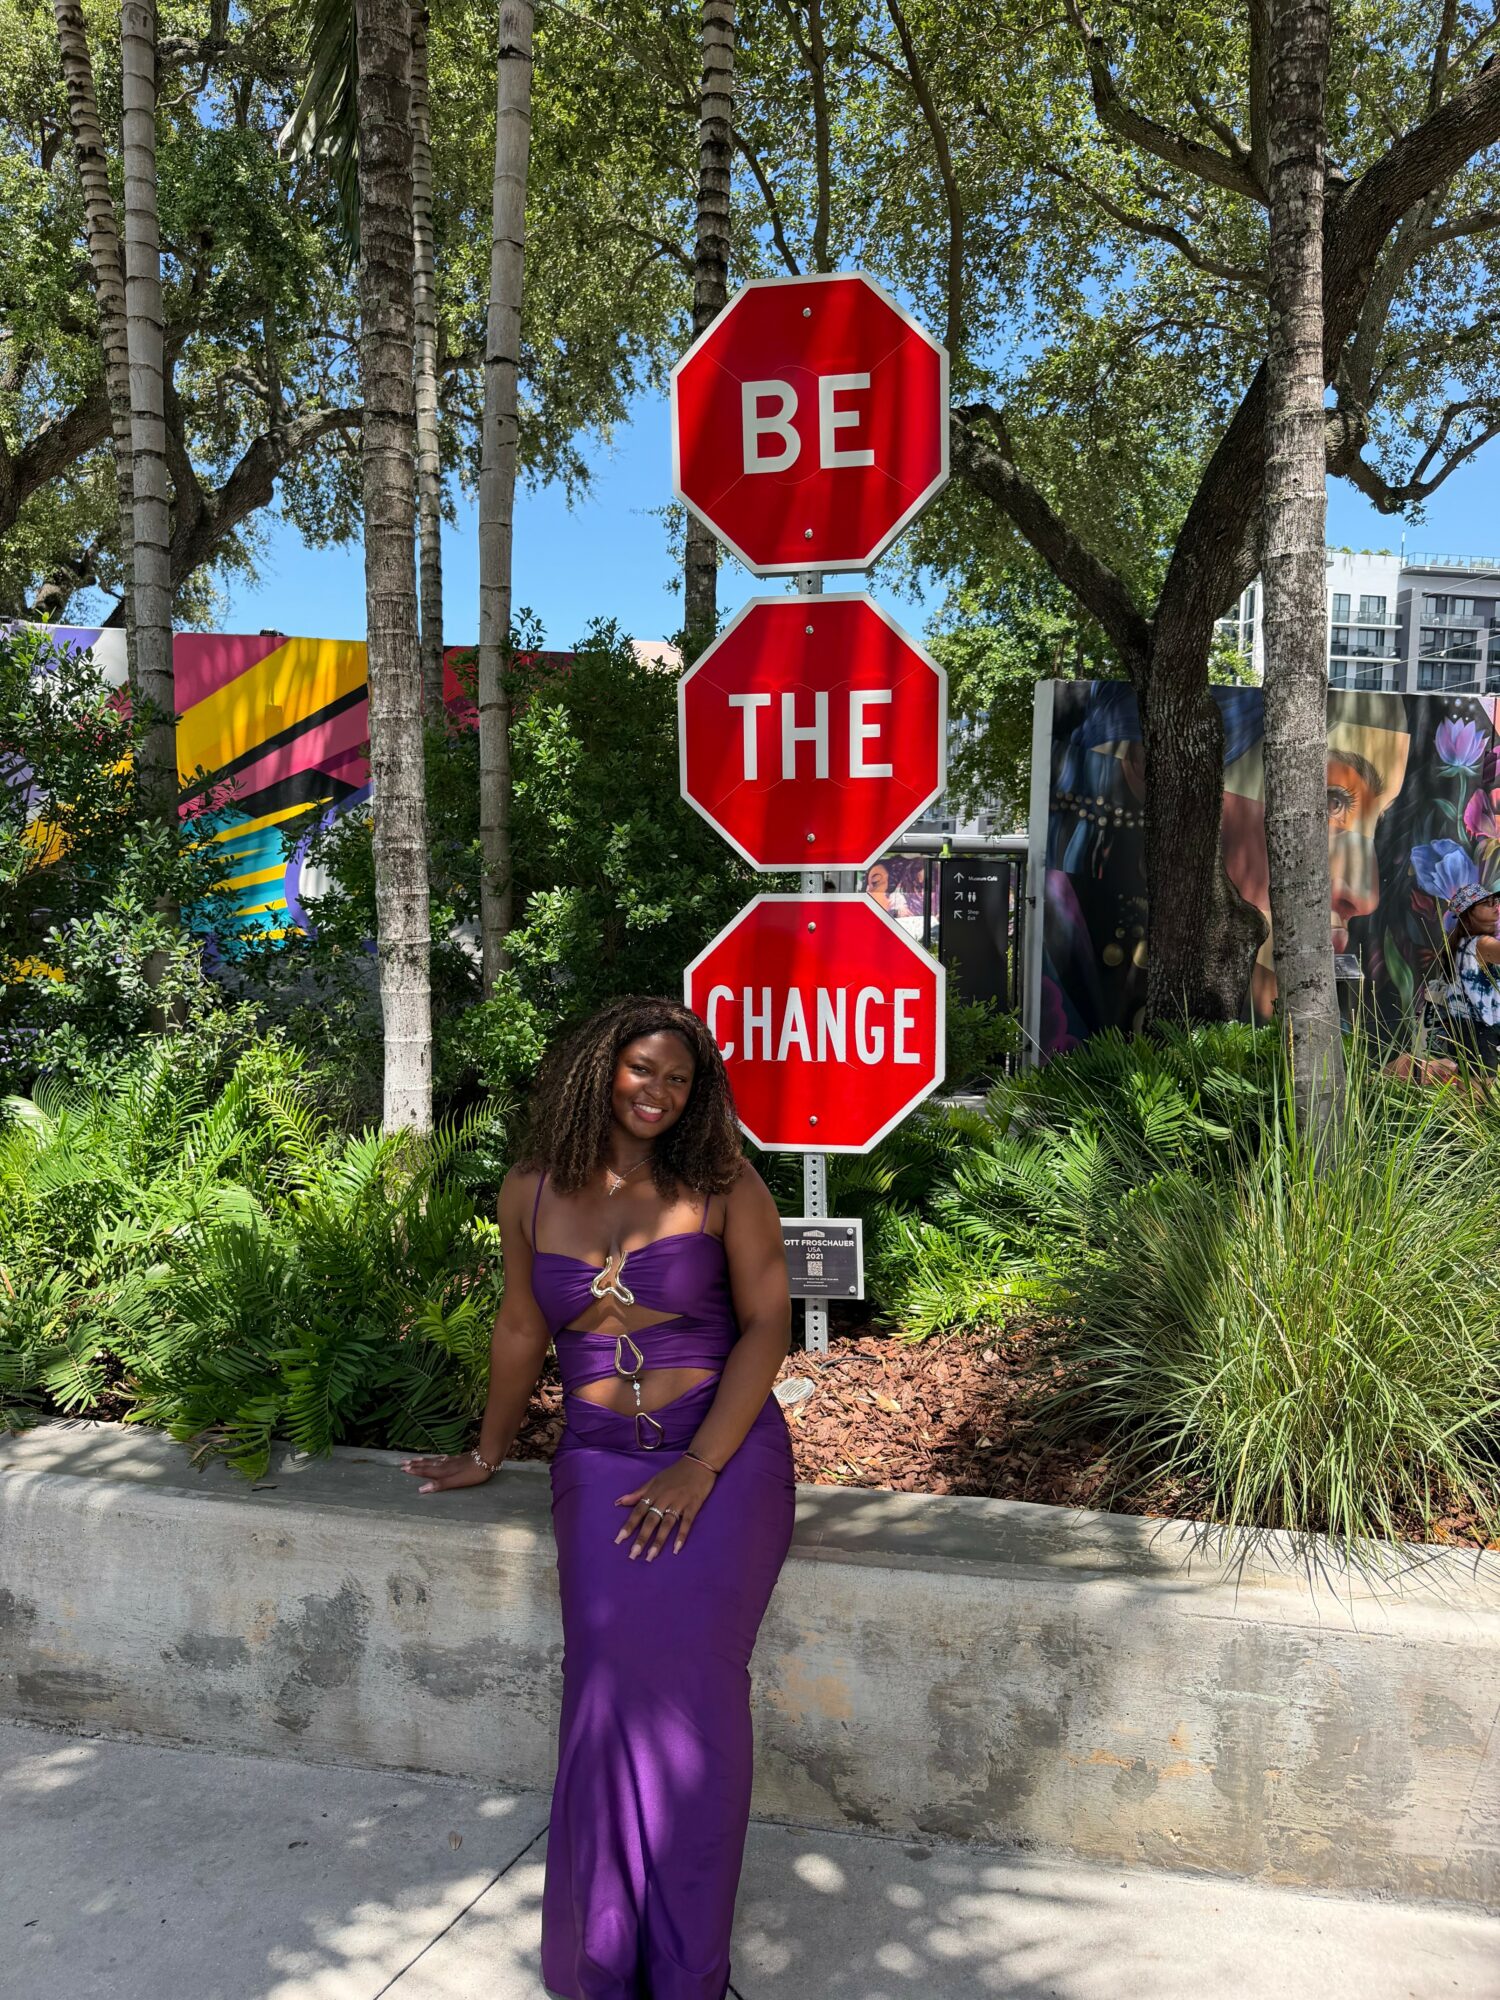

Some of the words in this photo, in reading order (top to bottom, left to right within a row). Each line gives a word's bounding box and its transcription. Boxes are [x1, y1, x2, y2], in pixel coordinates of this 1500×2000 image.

[741, 372, 875, 475] BE
[728, 689, 893, 781] THE
[706, 984, 921, 1065] CHANGE
[801, 1239, 855, 1247] FROSCHAUER
[805, 1252, 824, 1260] 2021
